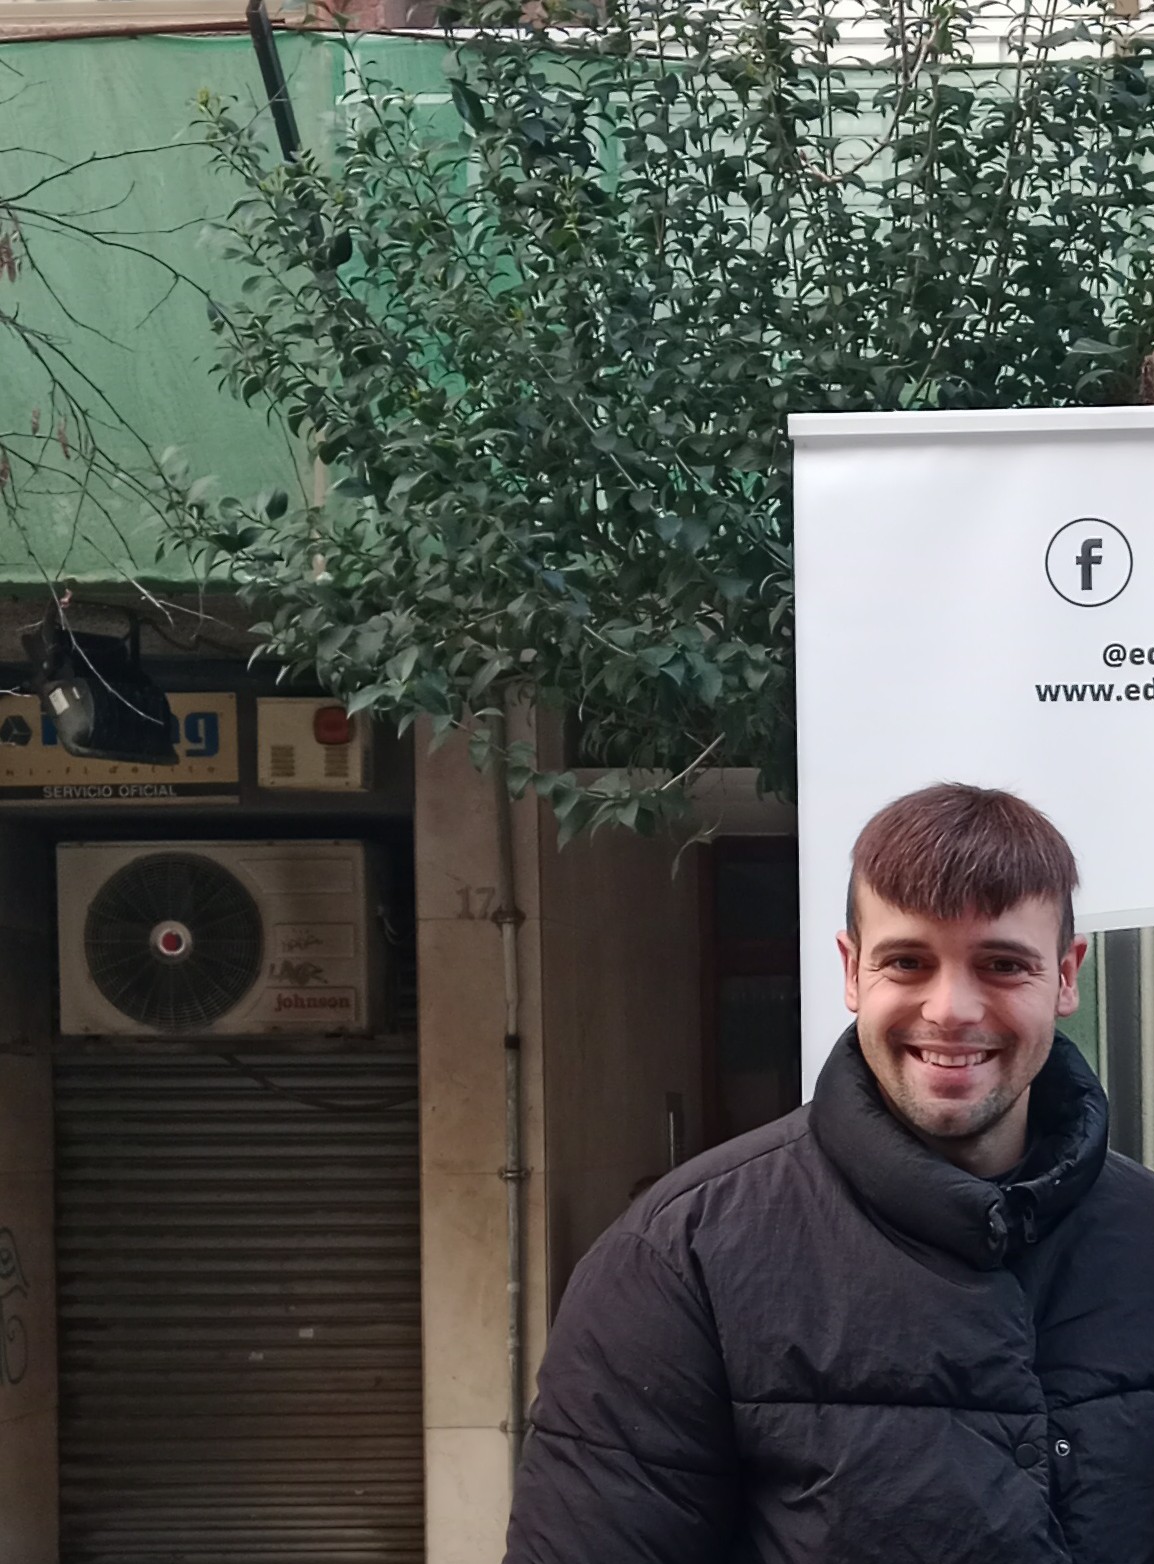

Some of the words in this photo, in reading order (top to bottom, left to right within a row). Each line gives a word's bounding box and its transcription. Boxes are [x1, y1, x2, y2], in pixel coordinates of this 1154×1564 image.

[43, 785, 113, 799] SERVICIO
[118, 783, 177, 798] OFICIAL
[274, 993, 350, 1012] johnson
